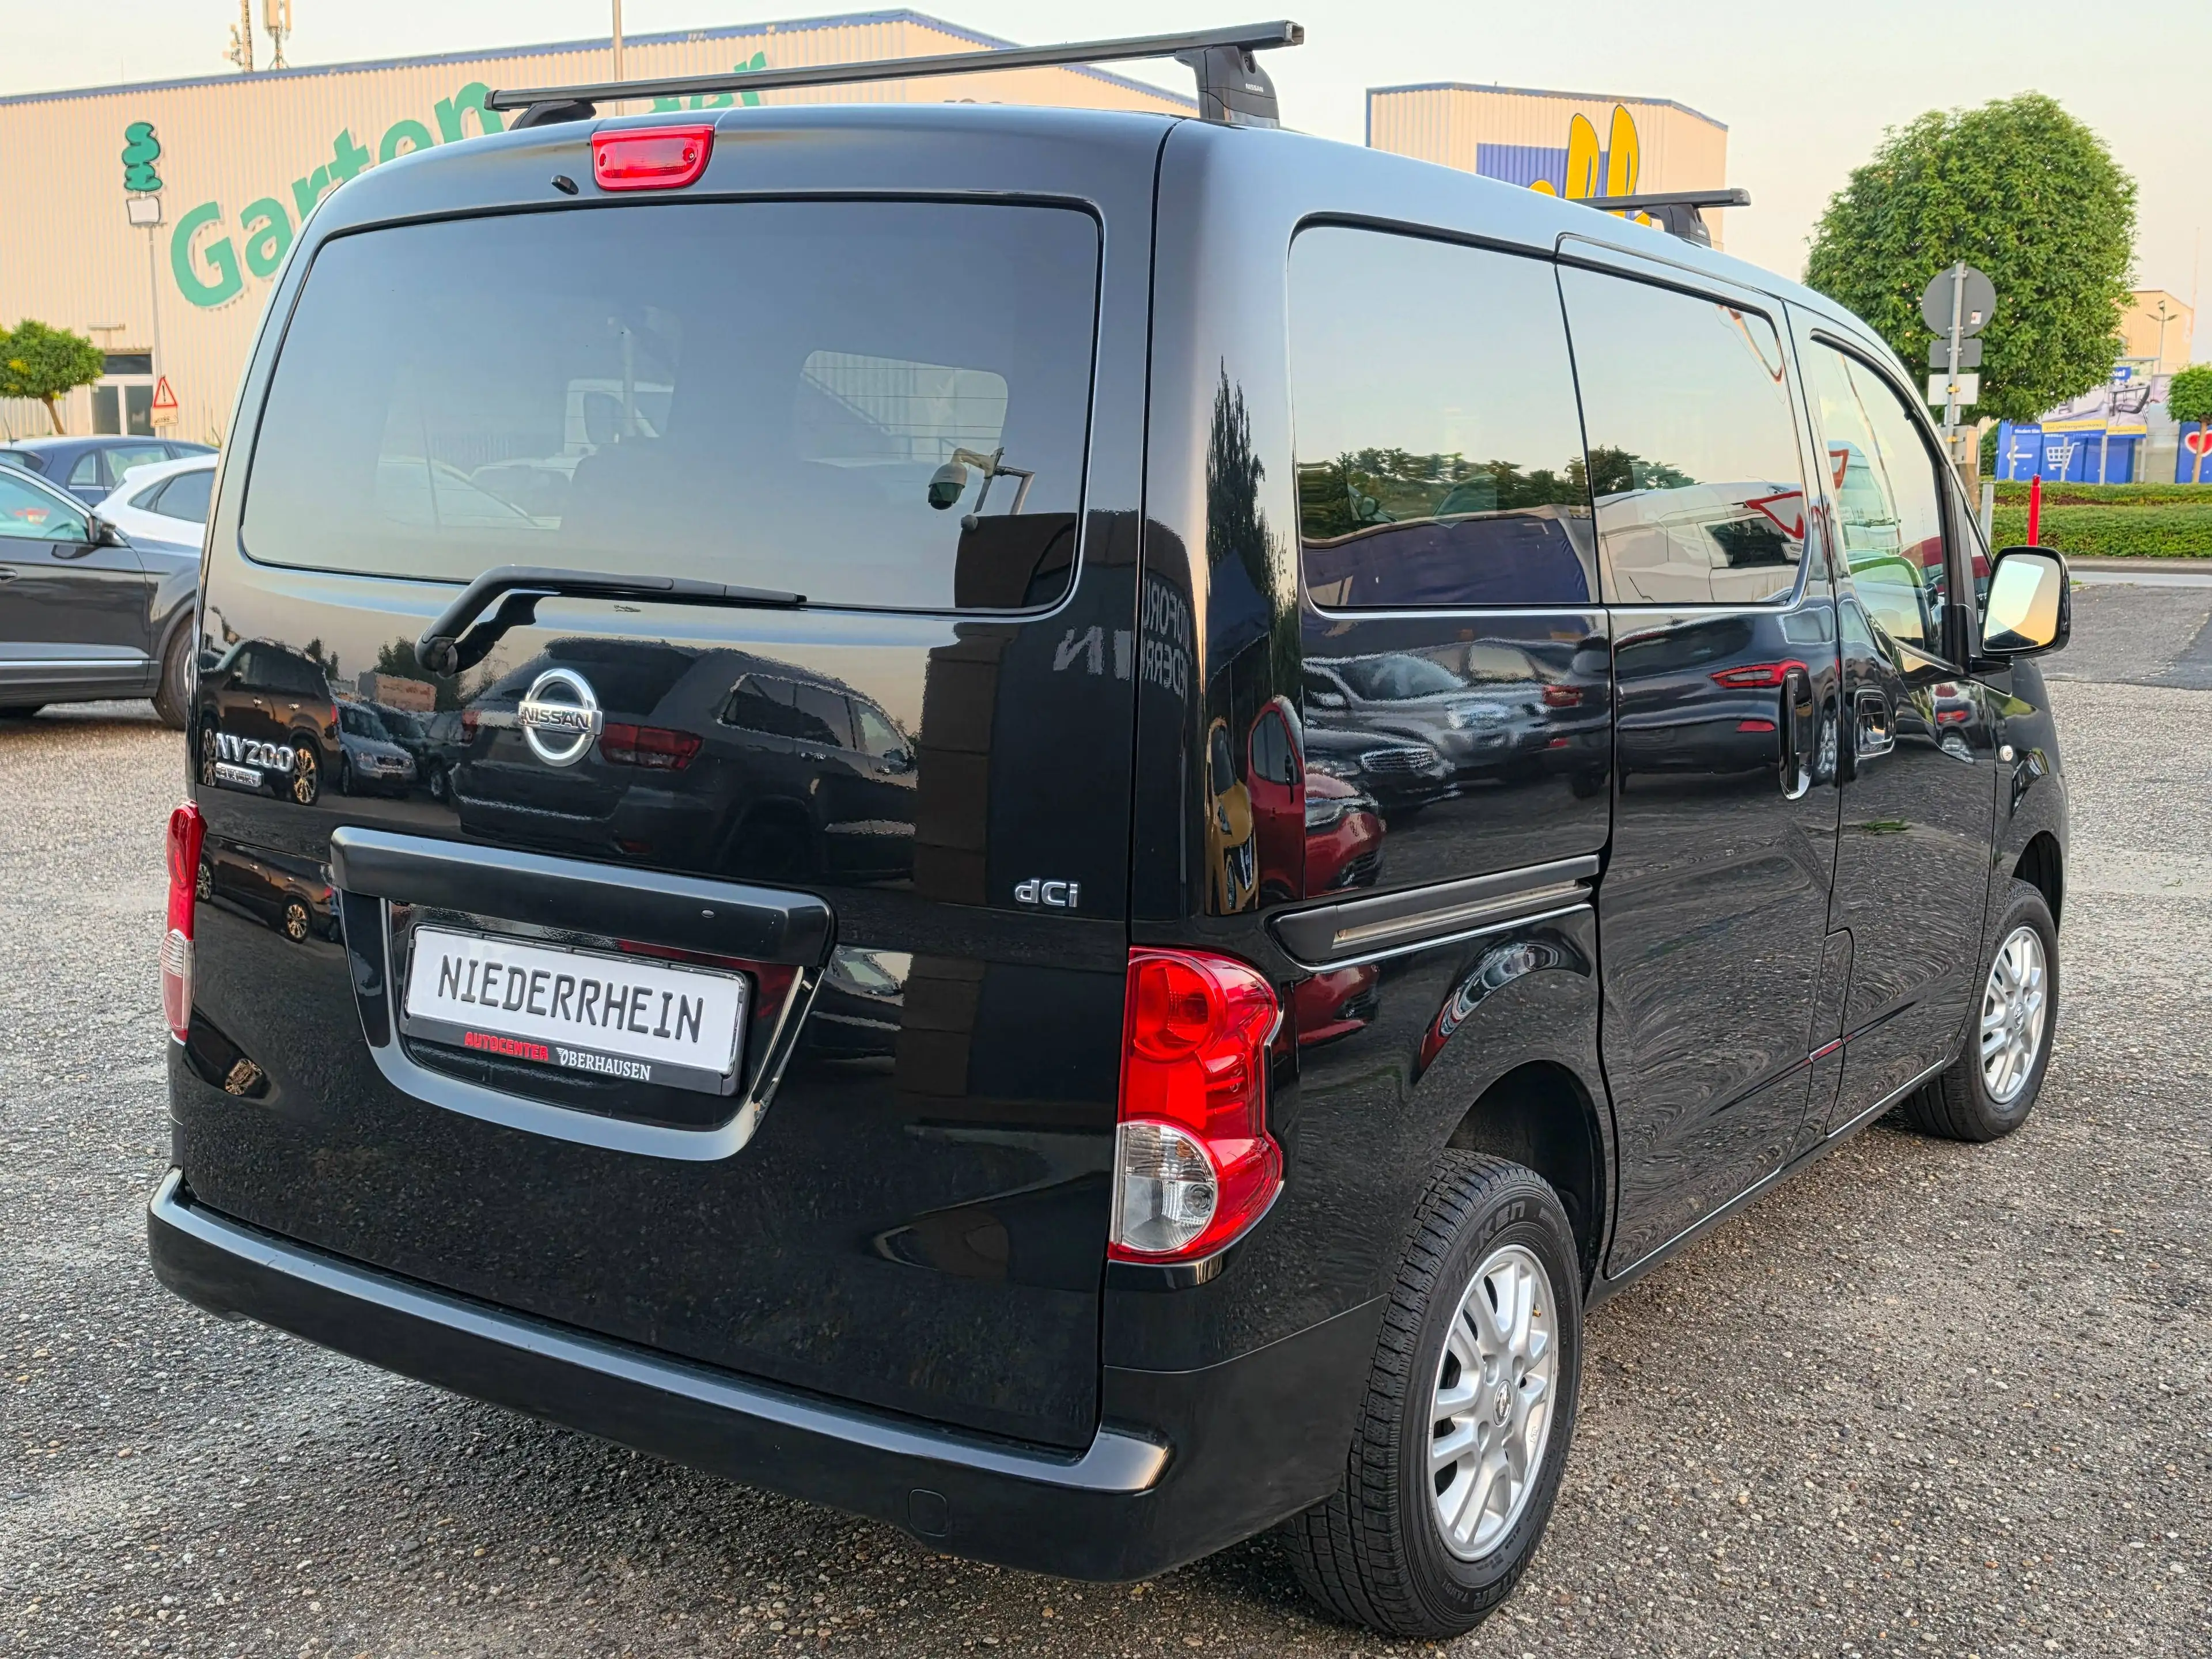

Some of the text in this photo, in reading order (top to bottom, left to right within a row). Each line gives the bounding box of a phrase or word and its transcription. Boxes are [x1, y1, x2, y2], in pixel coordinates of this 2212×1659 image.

[1245, 83, 1264, 92] NISSAN
[523, 707, 589, 729] NISSAN
[216, 732, 294, 772] NV200
[1015, 880, 1078, 907] dCi
[438, 955, 704, 1043] NIEDERRHEIN
[464, 1032, 652, 1081] AUTOCENTER OBERHAUSEN
